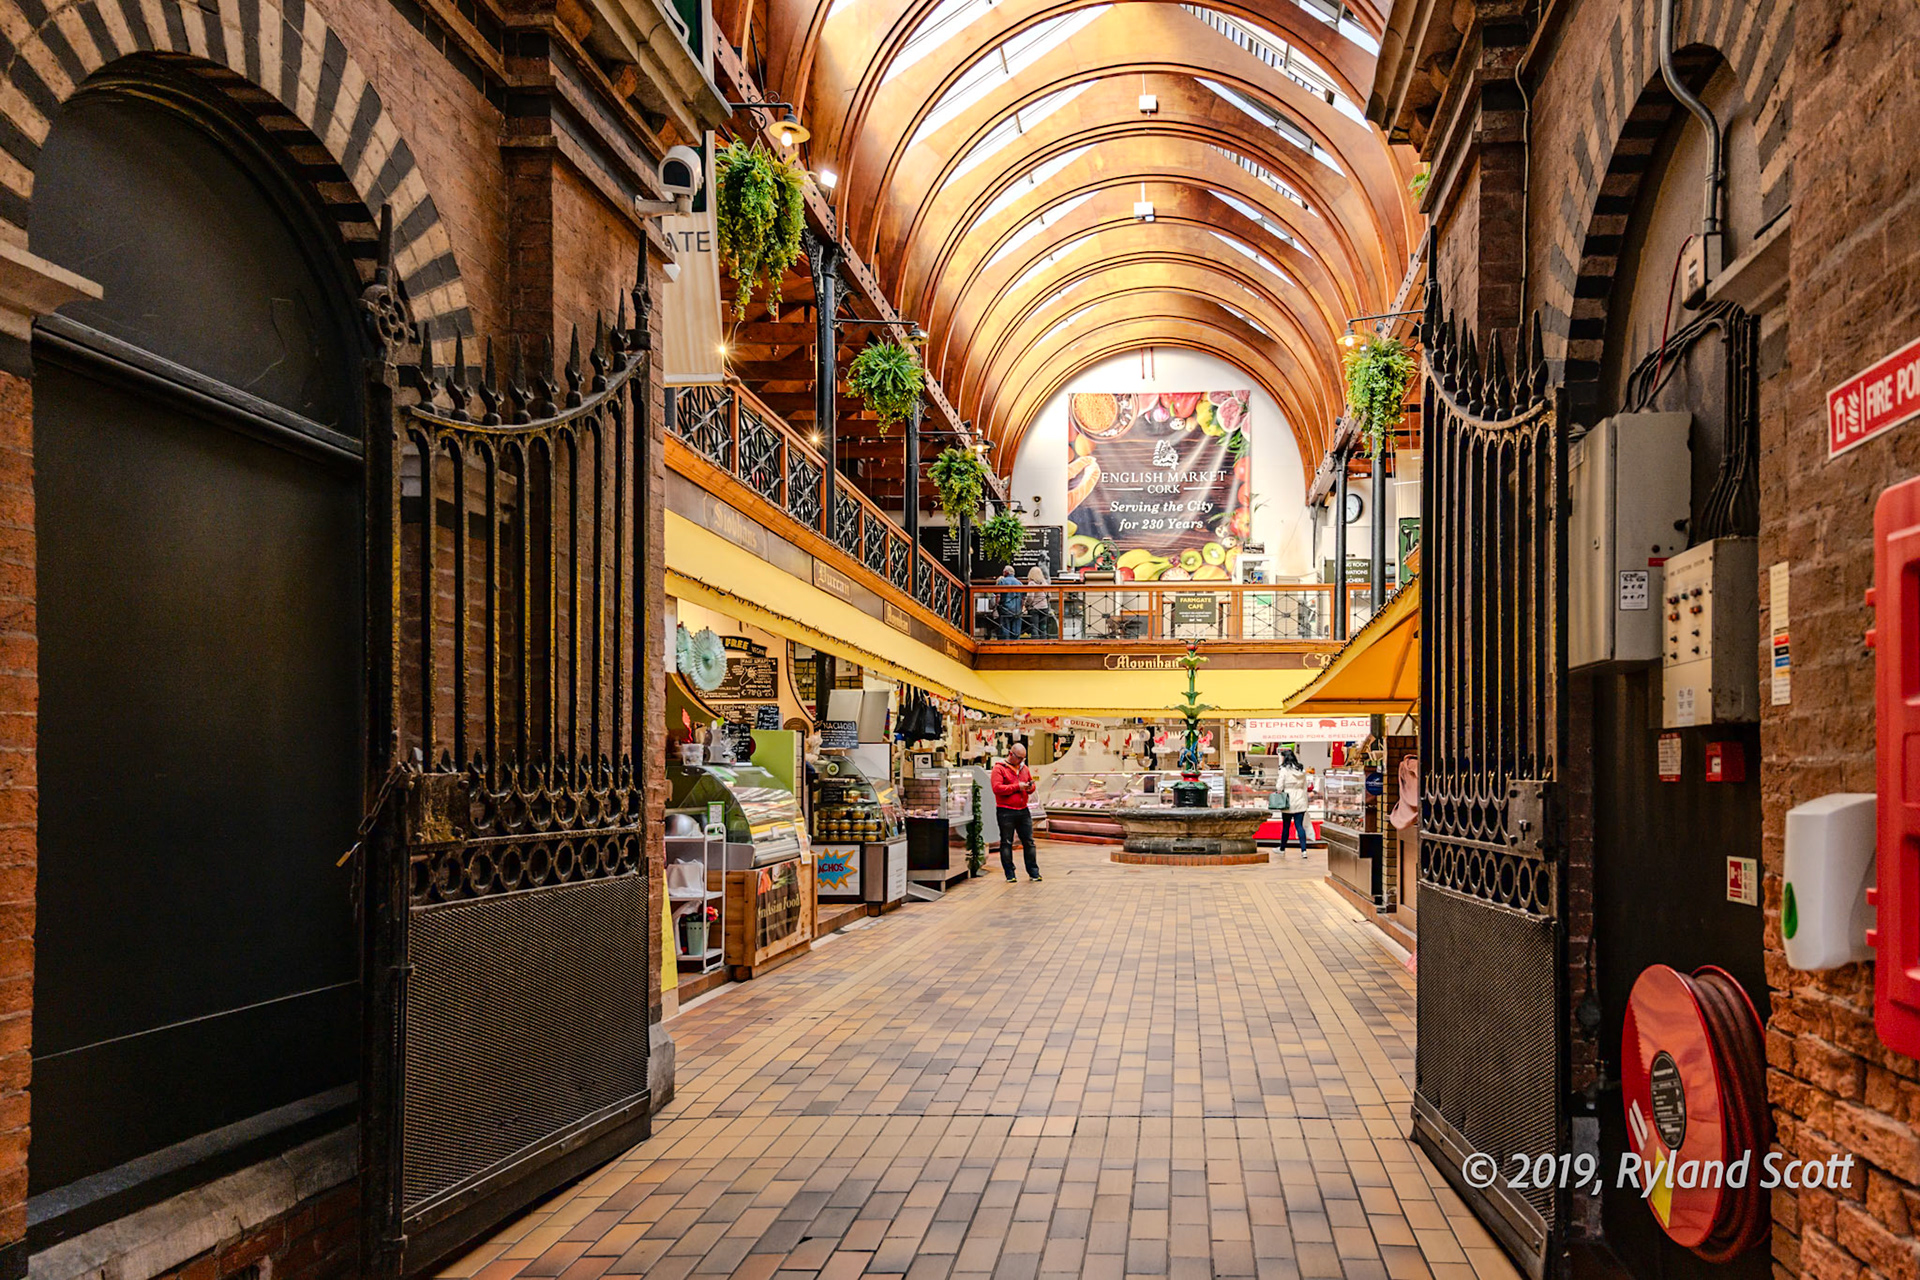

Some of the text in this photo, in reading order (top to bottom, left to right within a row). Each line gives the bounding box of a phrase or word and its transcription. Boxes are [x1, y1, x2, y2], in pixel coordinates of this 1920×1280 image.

[1866, 374, 1893, 421] FIRE
[1101, 470, 1227, 483] ENGLISH MARKET
[1147, 484, 1180, 494] CORK
[1110, 500, 1213, 514] Serving the City
[1119, 518, 1203, 531] for 230 Years
[724, 638, 749, 650] FREE
[1115, 654, 1179, 669] Moynihan
[1070, 720, 1101, 729] OULTRY
[818, 863, 844, 873] ACHOS
[783, 893, 800, 910] Food
